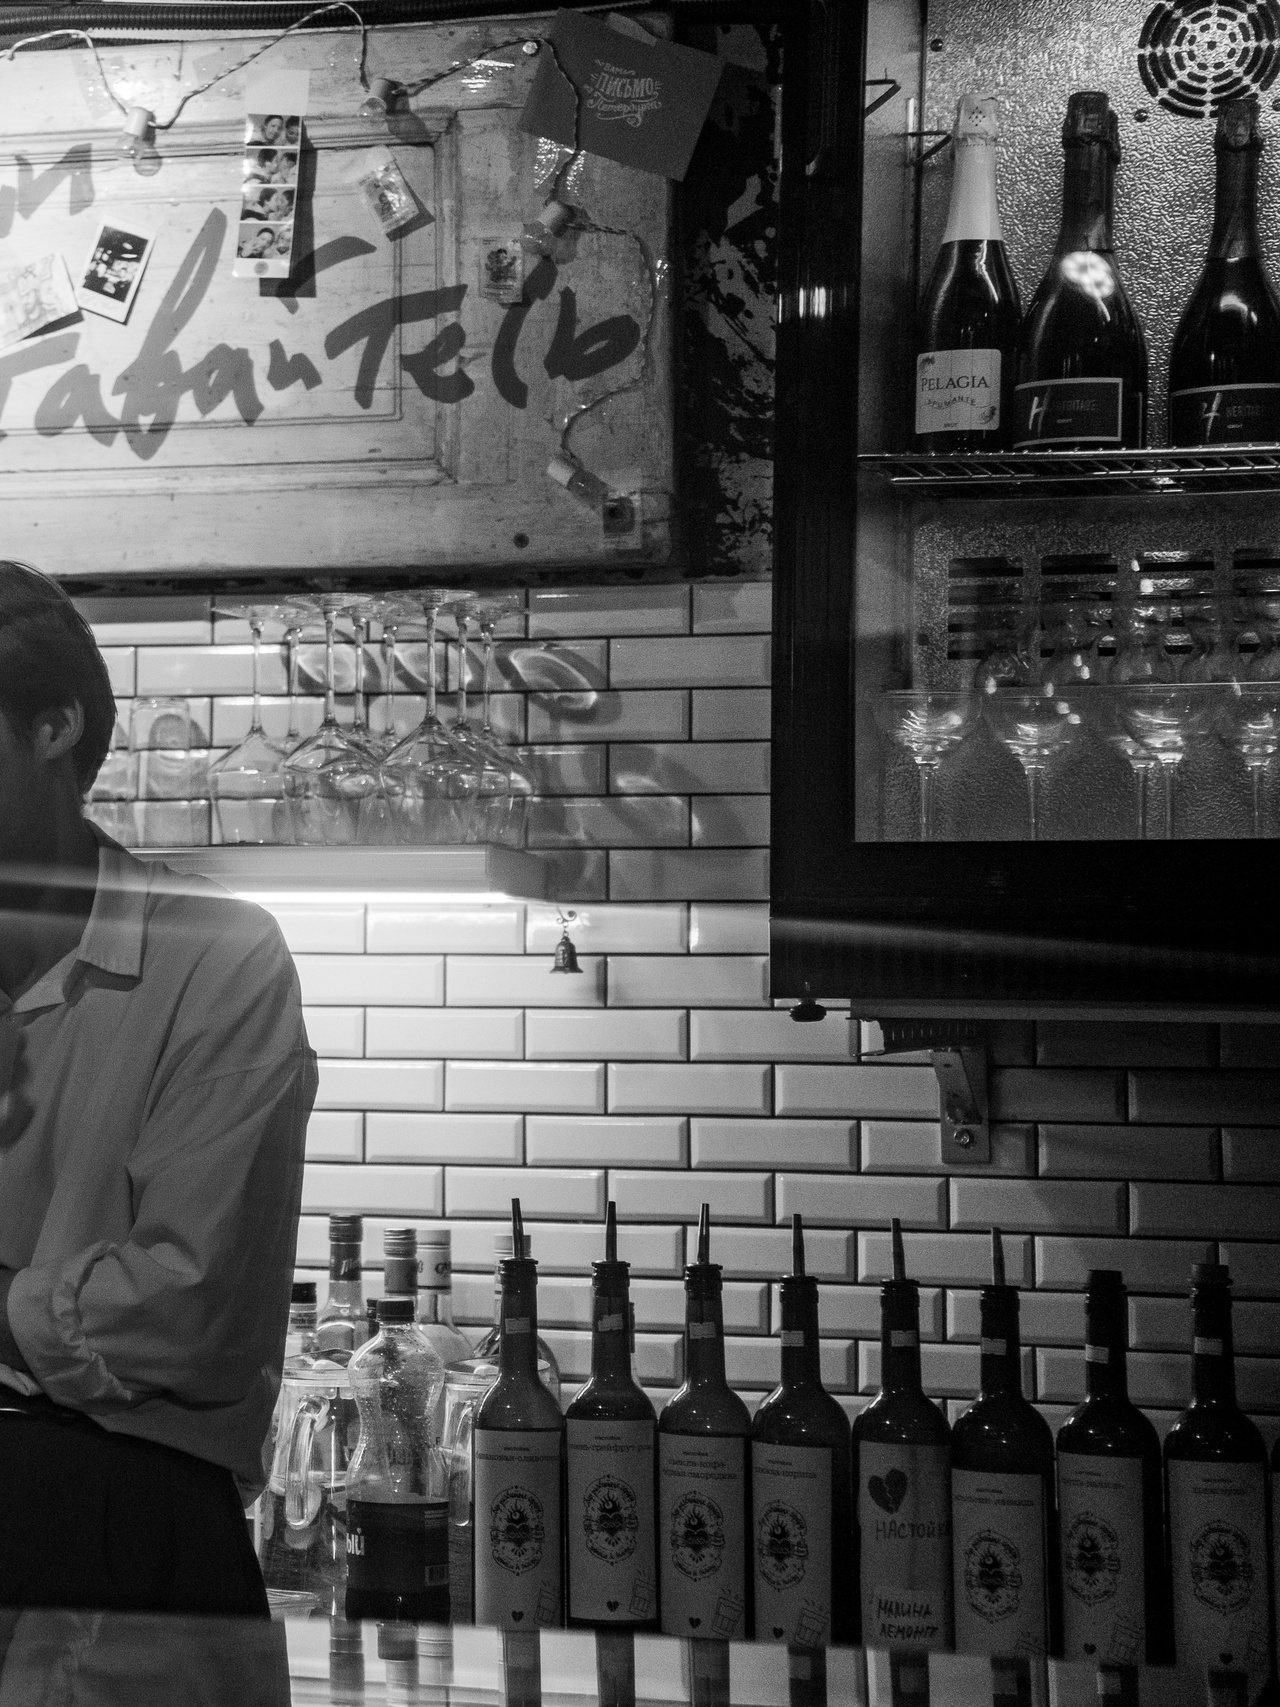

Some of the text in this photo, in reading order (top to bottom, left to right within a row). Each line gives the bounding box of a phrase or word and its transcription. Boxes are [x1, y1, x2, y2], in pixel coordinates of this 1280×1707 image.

[595, 72, 654, 98] ПИСЬМО
[921, 375, 990, 392] PELAGIA
[927, 394, 976, 409] SPUMANTE
[876, 1598, 933, 1620] МАЛИНА
